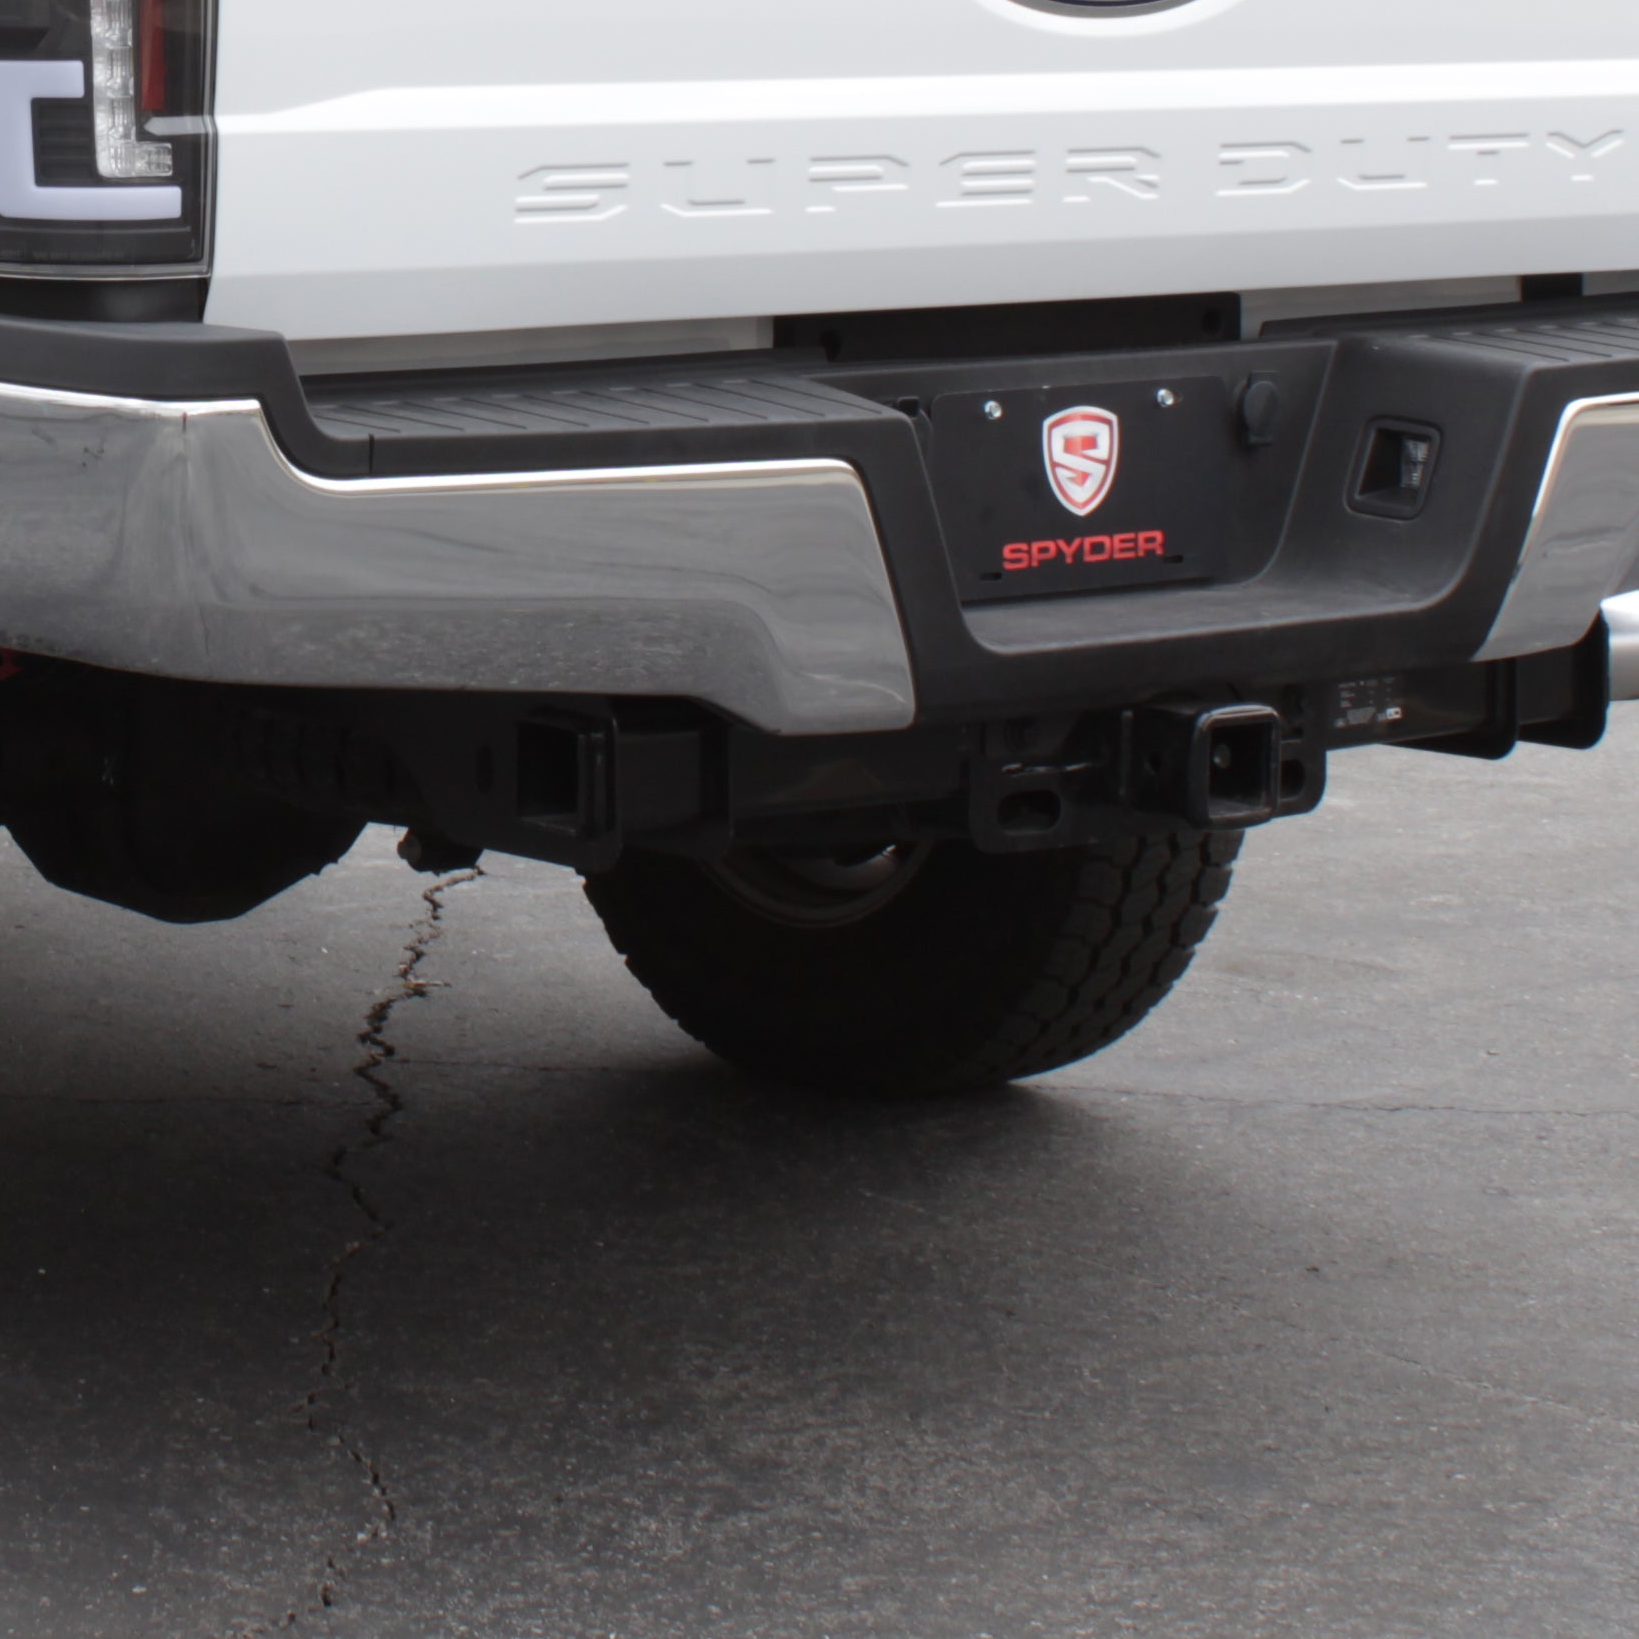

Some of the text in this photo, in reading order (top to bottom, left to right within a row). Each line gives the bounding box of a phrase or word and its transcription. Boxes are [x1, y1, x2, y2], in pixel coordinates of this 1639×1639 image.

[514, 128, 1625, 224] SUPER DUTY
[1002, 530, 1165, 570] SPYDER
